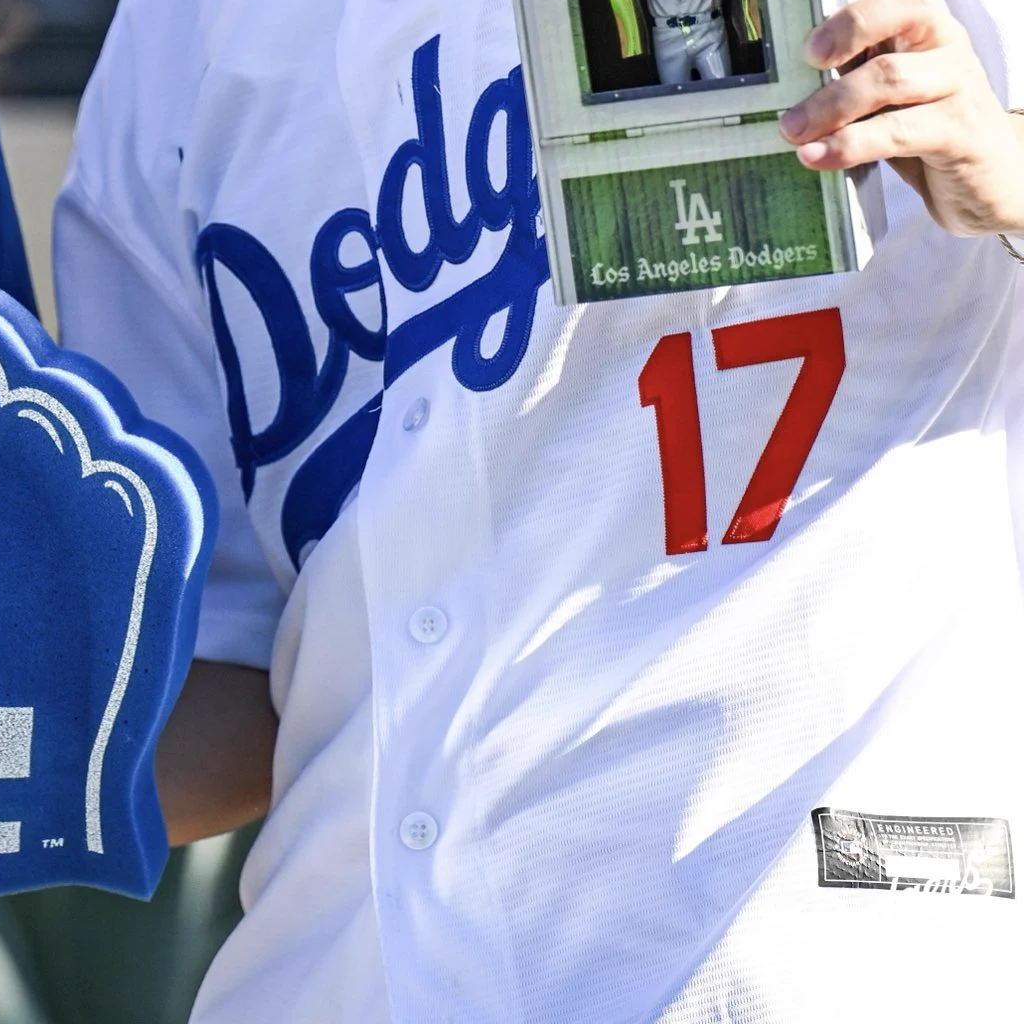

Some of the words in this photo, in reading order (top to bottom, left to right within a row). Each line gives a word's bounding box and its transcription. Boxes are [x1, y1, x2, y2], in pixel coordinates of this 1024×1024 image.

[669, 179, 723, 246] LA
[196, 35, 550, 504] Dodg
[590, 262, 630, 286] Los
[636, 252, 722, 282] Angeles
[728, 243, 817, 271] Dodgers
[637, 306, 847, 556] 17
[41, 837, 64, 848] TM
[876, 824, 955, 837] ENGINEERED
